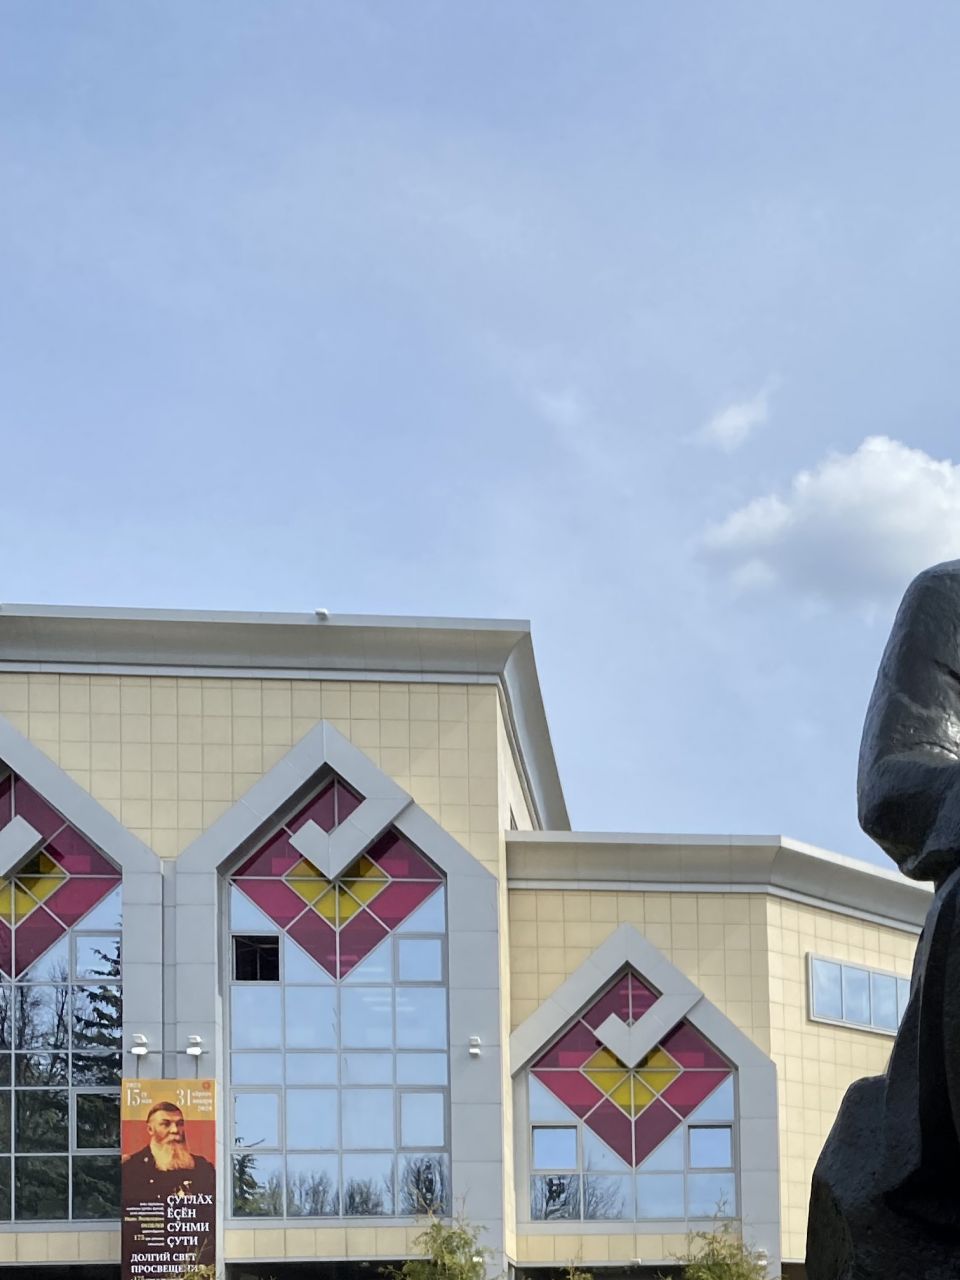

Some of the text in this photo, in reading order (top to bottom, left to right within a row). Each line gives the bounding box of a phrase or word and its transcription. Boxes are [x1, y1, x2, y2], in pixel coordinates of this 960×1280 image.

[127, 1088, 141, 1107] 15
[176, 1088, 191, 1107] 31
[130, 1252, 197, 1263] ДОЛГИЙ СВЕТ
[130, 1264, 203, 1274] ПРОСВЕЩЕИ
